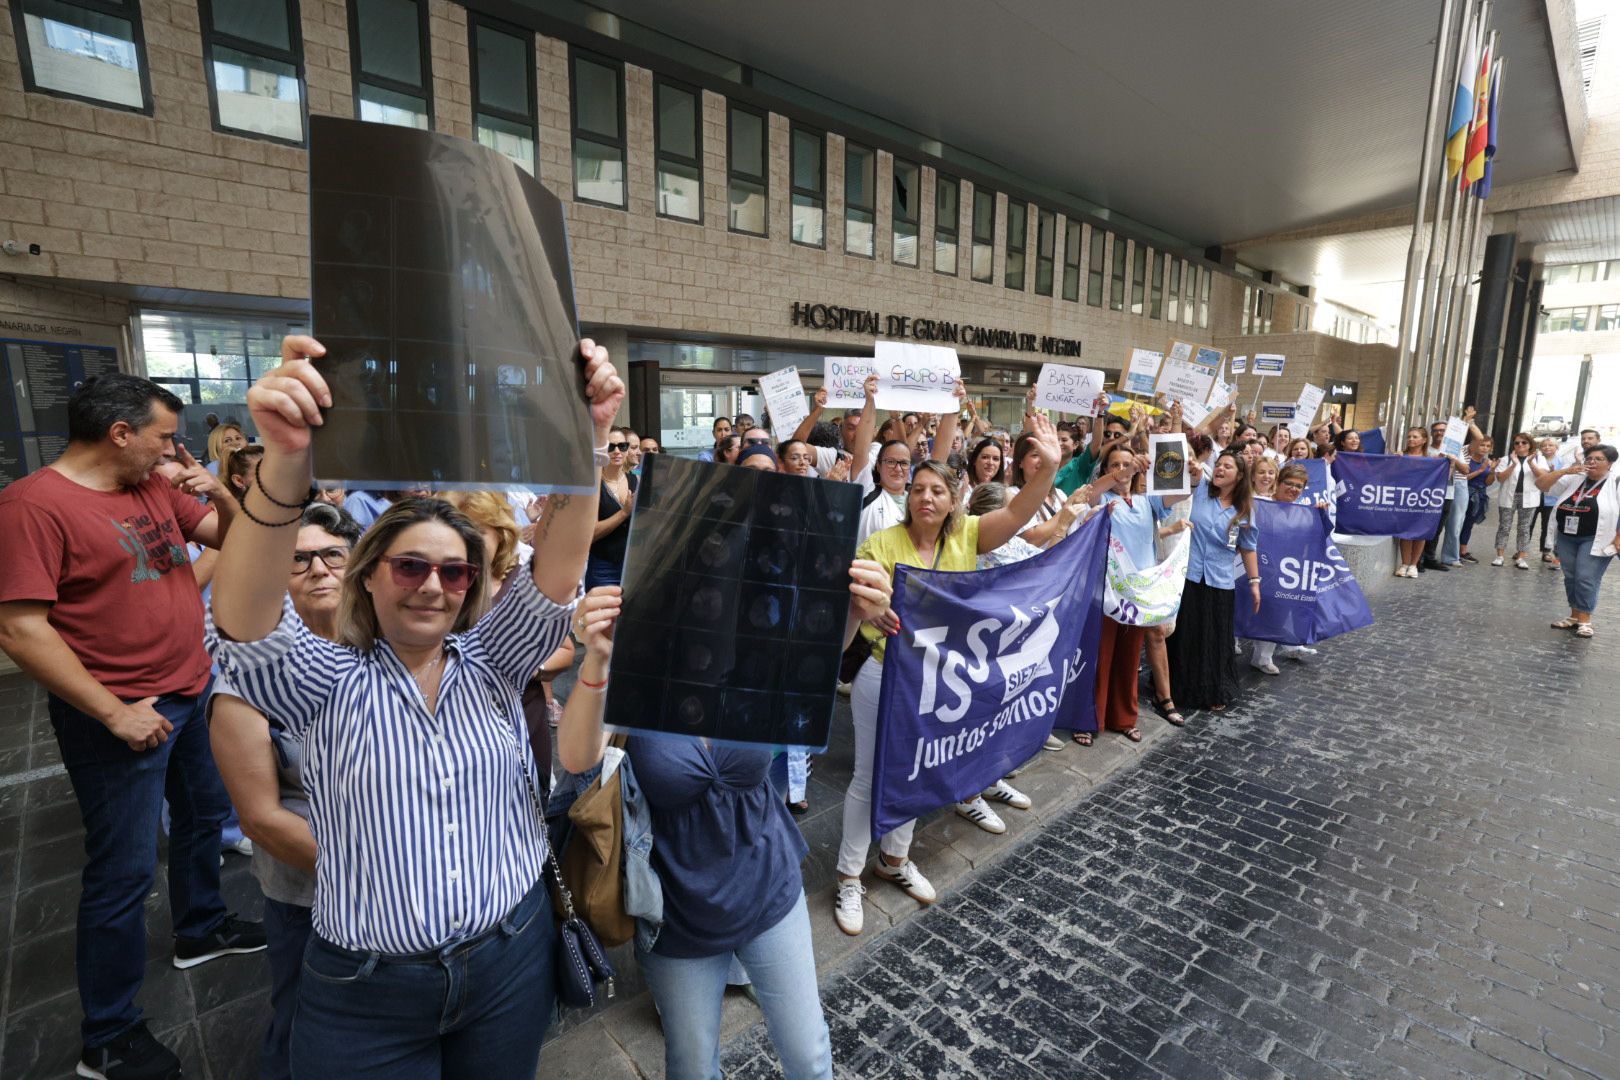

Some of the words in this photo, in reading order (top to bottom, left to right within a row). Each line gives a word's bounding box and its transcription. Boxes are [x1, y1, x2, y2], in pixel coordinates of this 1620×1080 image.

[791, 301, 884, 336] HOSPITAL
[886, 314, 911, 338] DE
[912, 318, 958, 344] GRAN
[960, 324, 1018, 350] CANARIA
[1018, 332, 1038, 352] DR.
[832, 376, 865, 390] NUES
[890, 364, 938, 384] GRUPO
[1046, 368, 1090, 387] BASTA
[835, 389, 866, 399] GRAD
[1062, 386, 1075, 395] DE
[1359, 484, 1445, 508] SIETeSS
[907, 720, 989, 782] Juntos
[988, 686, 1058, 737] somos
